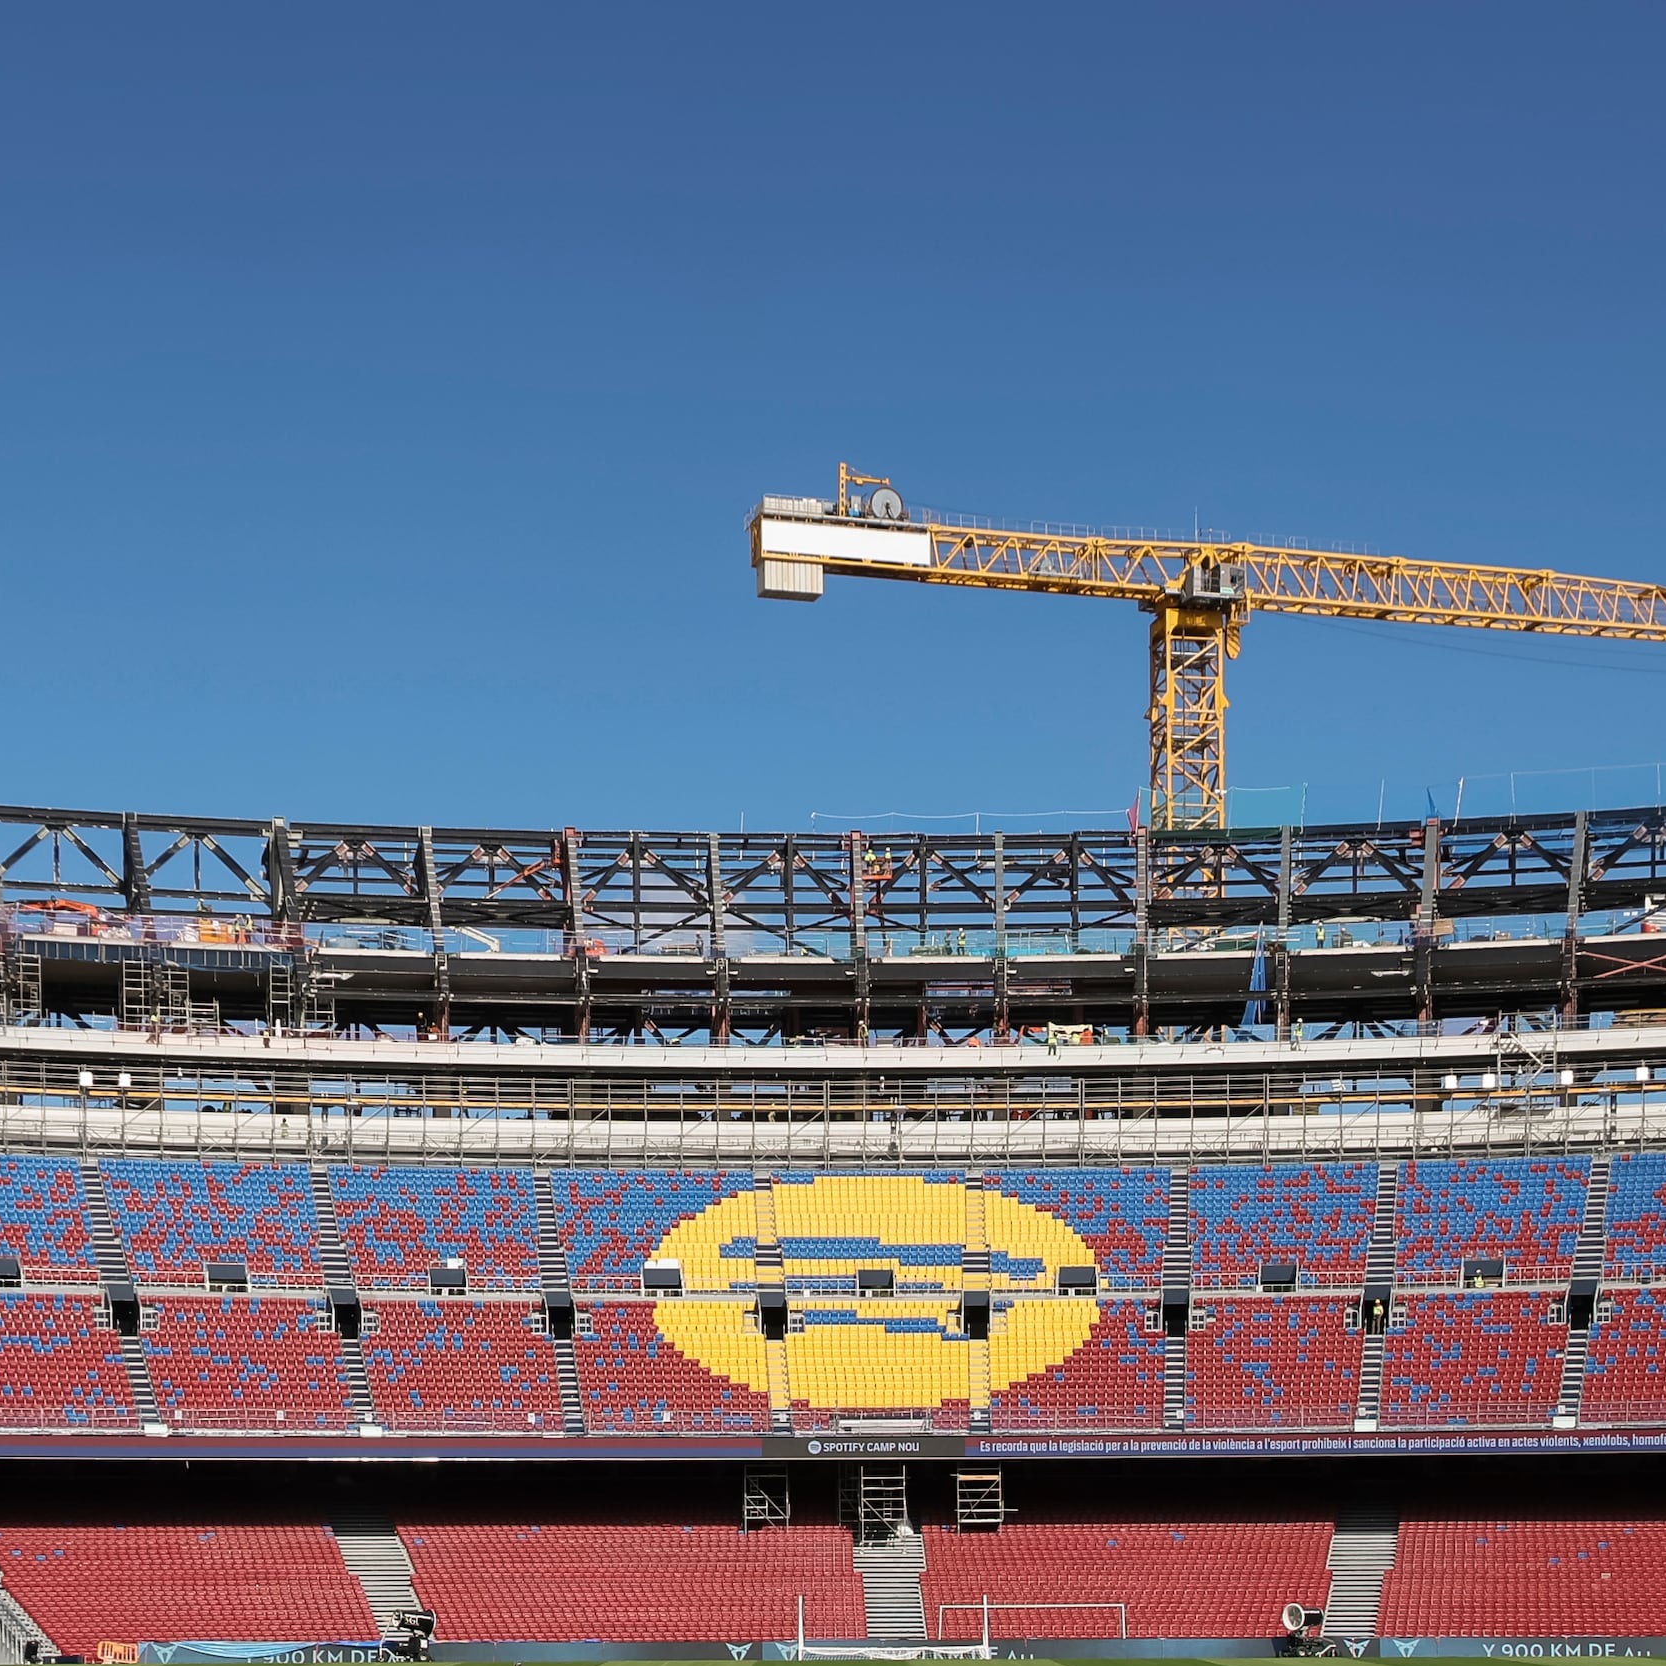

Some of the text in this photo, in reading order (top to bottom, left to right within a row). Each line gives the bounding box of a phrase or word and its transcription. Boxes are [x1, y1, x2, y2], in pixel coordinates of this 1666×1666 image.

[823, 1442, 920, 1452] SPOTIFY CAMP NOU
[980, 1441, 990, 1452] Es
[992, 1440, 1028, 1452] recorda
[1030, 1442, 1046, 1454] que
[1048, 1440, 1058, 1451] la
[1059, 1439, 1103, 1454] legislació
[1106, 1441, 1121, 1453] per
[1122, 1441, 1129, 1451] a
[1130, 1439, 1139, 1451] la
[1140, 1438, 1187, 1452] prevenció
[1188, 1438, 1201, 1450] de
[1202, 1438, 1211, 1450] la
[1212, 1438, 1255, 1450] violència
[1256, 1441, 1262, 1450] a
[1264, 1438, 1301, 1451] l'esport
[1302, 1437, 1347, 1450] prohibeix
[1353, 1437, 1396, 1449] sanciona
[1398, 1437, 1406, 1448] la
[1408, 1436, 1465, 1450] participació
[1466, 1436, 1496, 1448] activa
[1498, 1438, 1510, 1447] en
[1511, 1437, 1539, 1447] actes
[1540, 1435, 1581, 1448] violents,
[1583, 1434, 1631, 1448] xenòfobs,
[313, 1650, 348, 1664] KM
[1501, 1643, 1544, 1657] 900
[1551, 1643, 1581, 1657] KM
